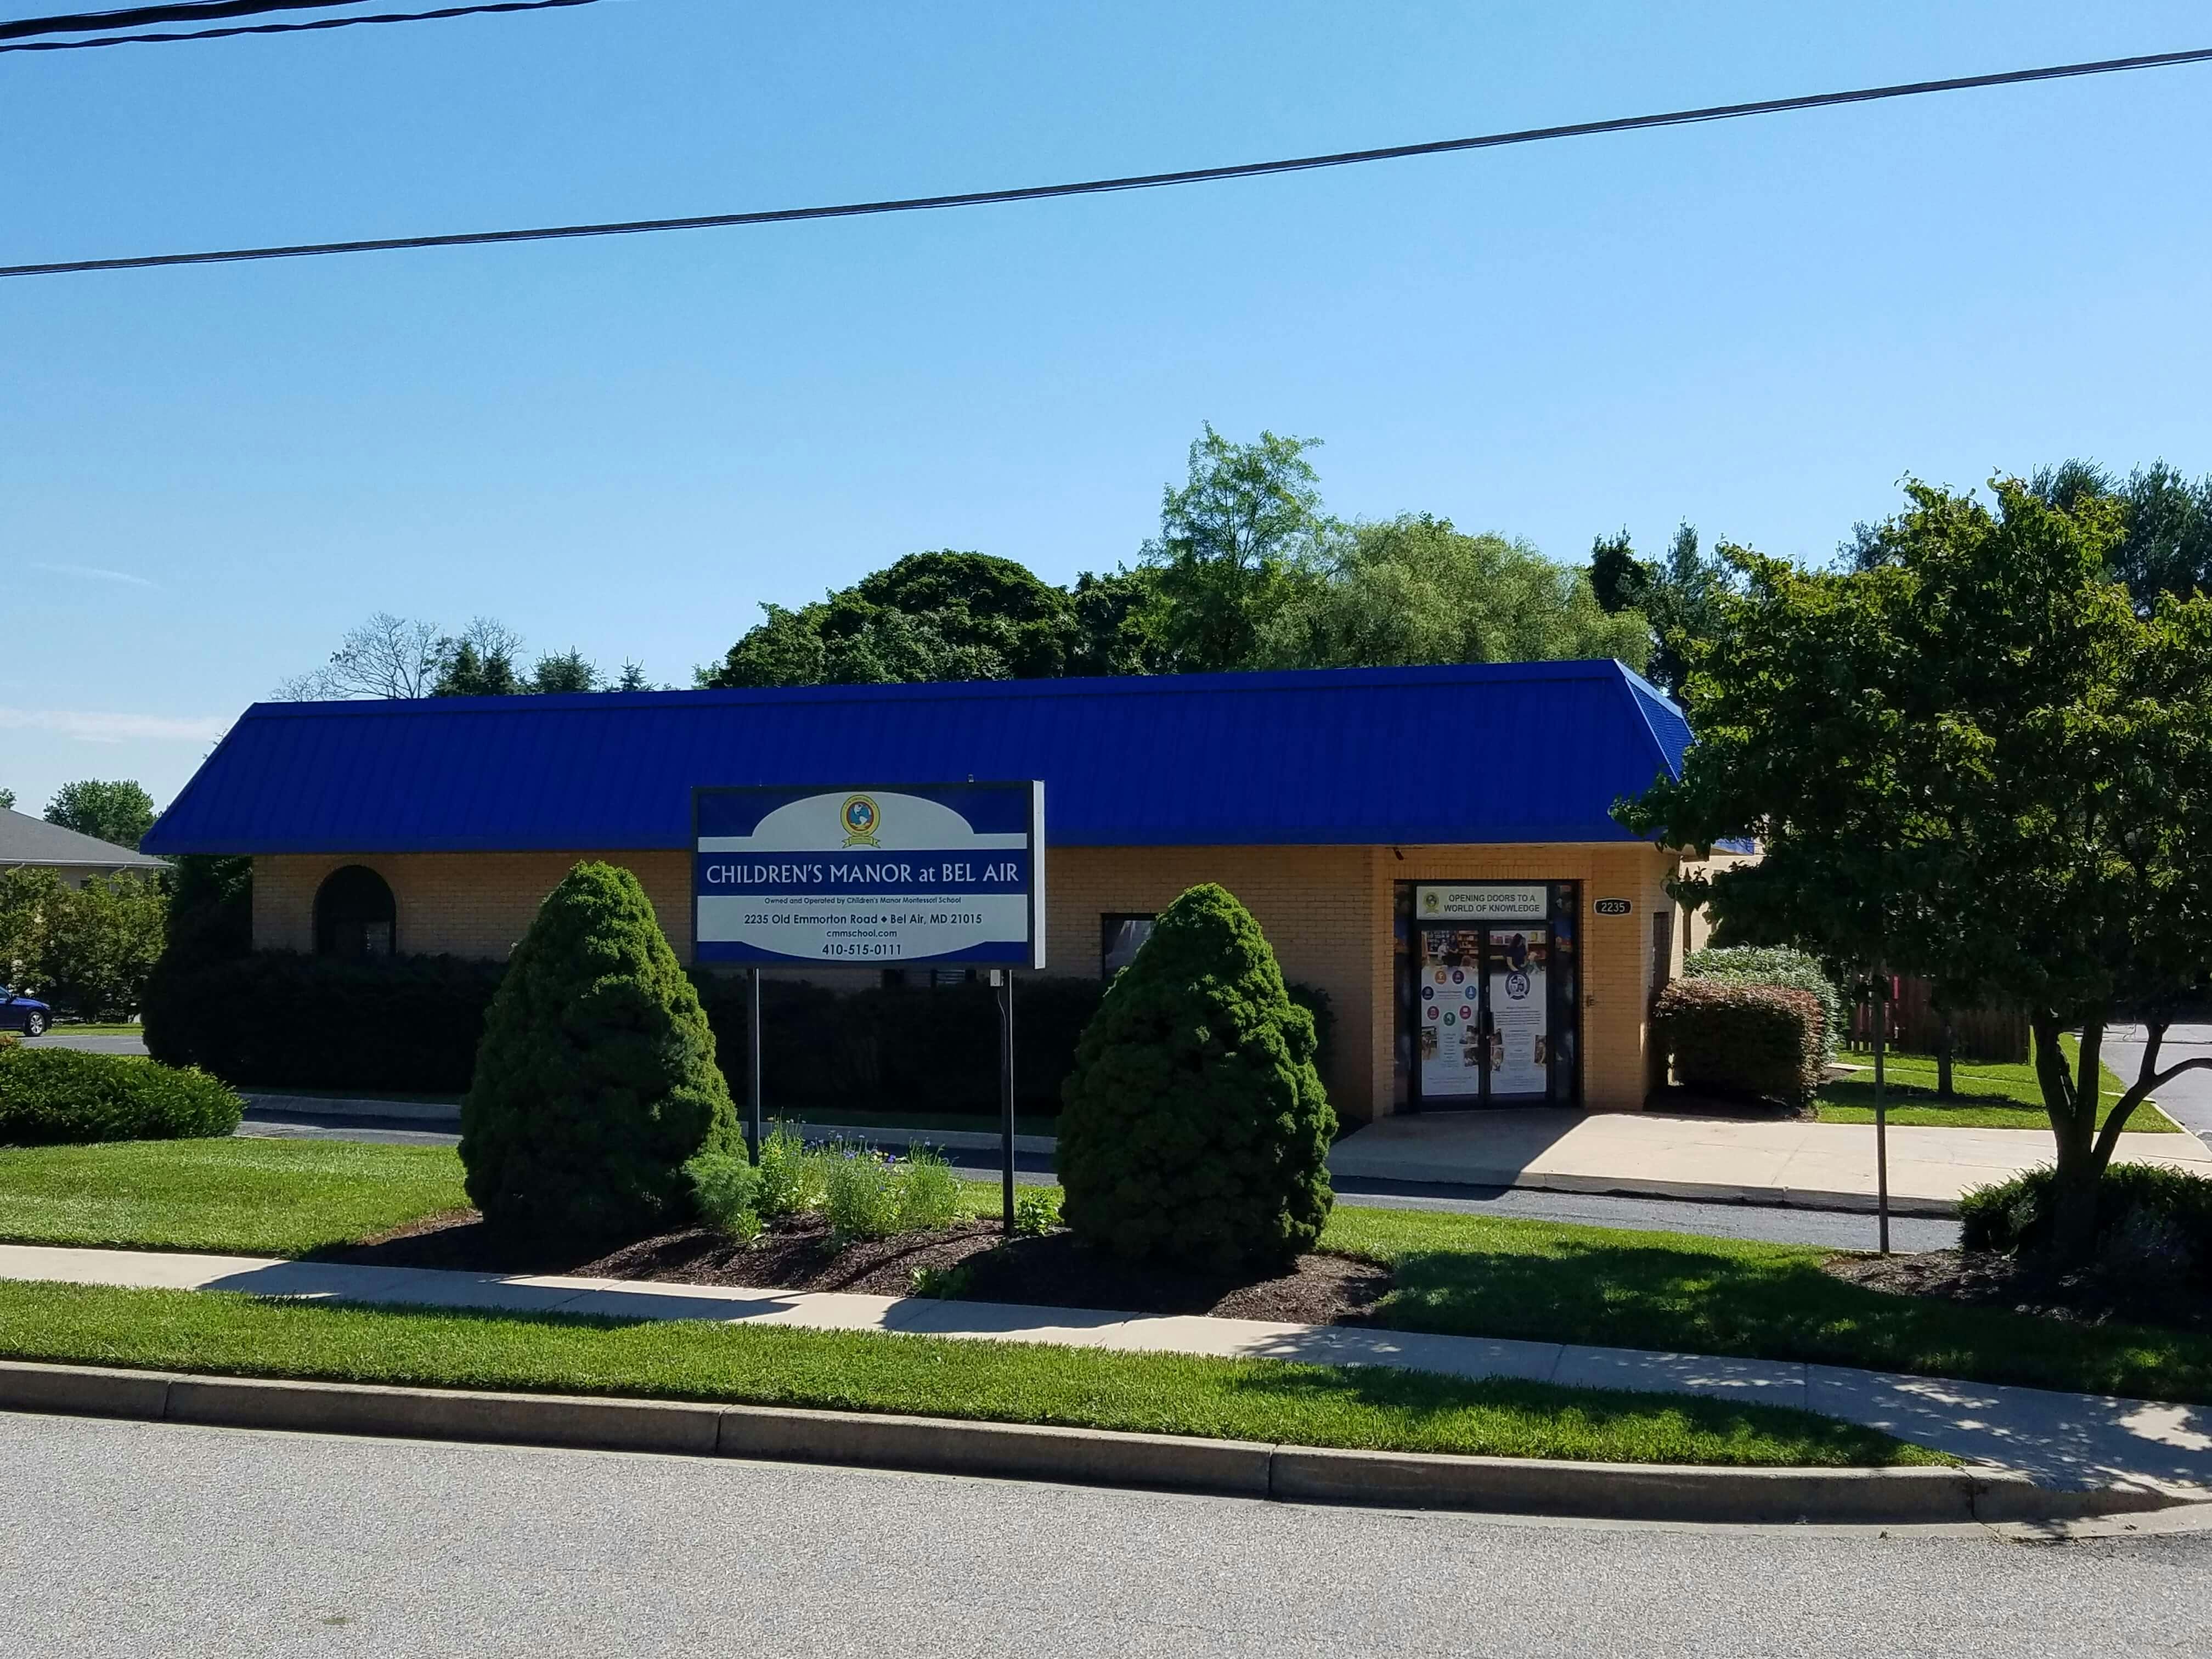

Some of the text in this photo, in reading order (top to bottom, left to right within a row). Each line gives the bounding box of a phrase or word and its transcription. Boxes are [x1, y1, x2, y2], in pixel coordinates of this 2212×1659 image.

[707, 863, 1019, 883] CHILDREN'S MANOR at BEL AIR
[1601, 902, 1625, 912] 2235
[744, 913, 982, 925] 2235 Old Emmorton Road Bel Air, MD 21015
[822, 944, 901, 955] 410-515-0111
